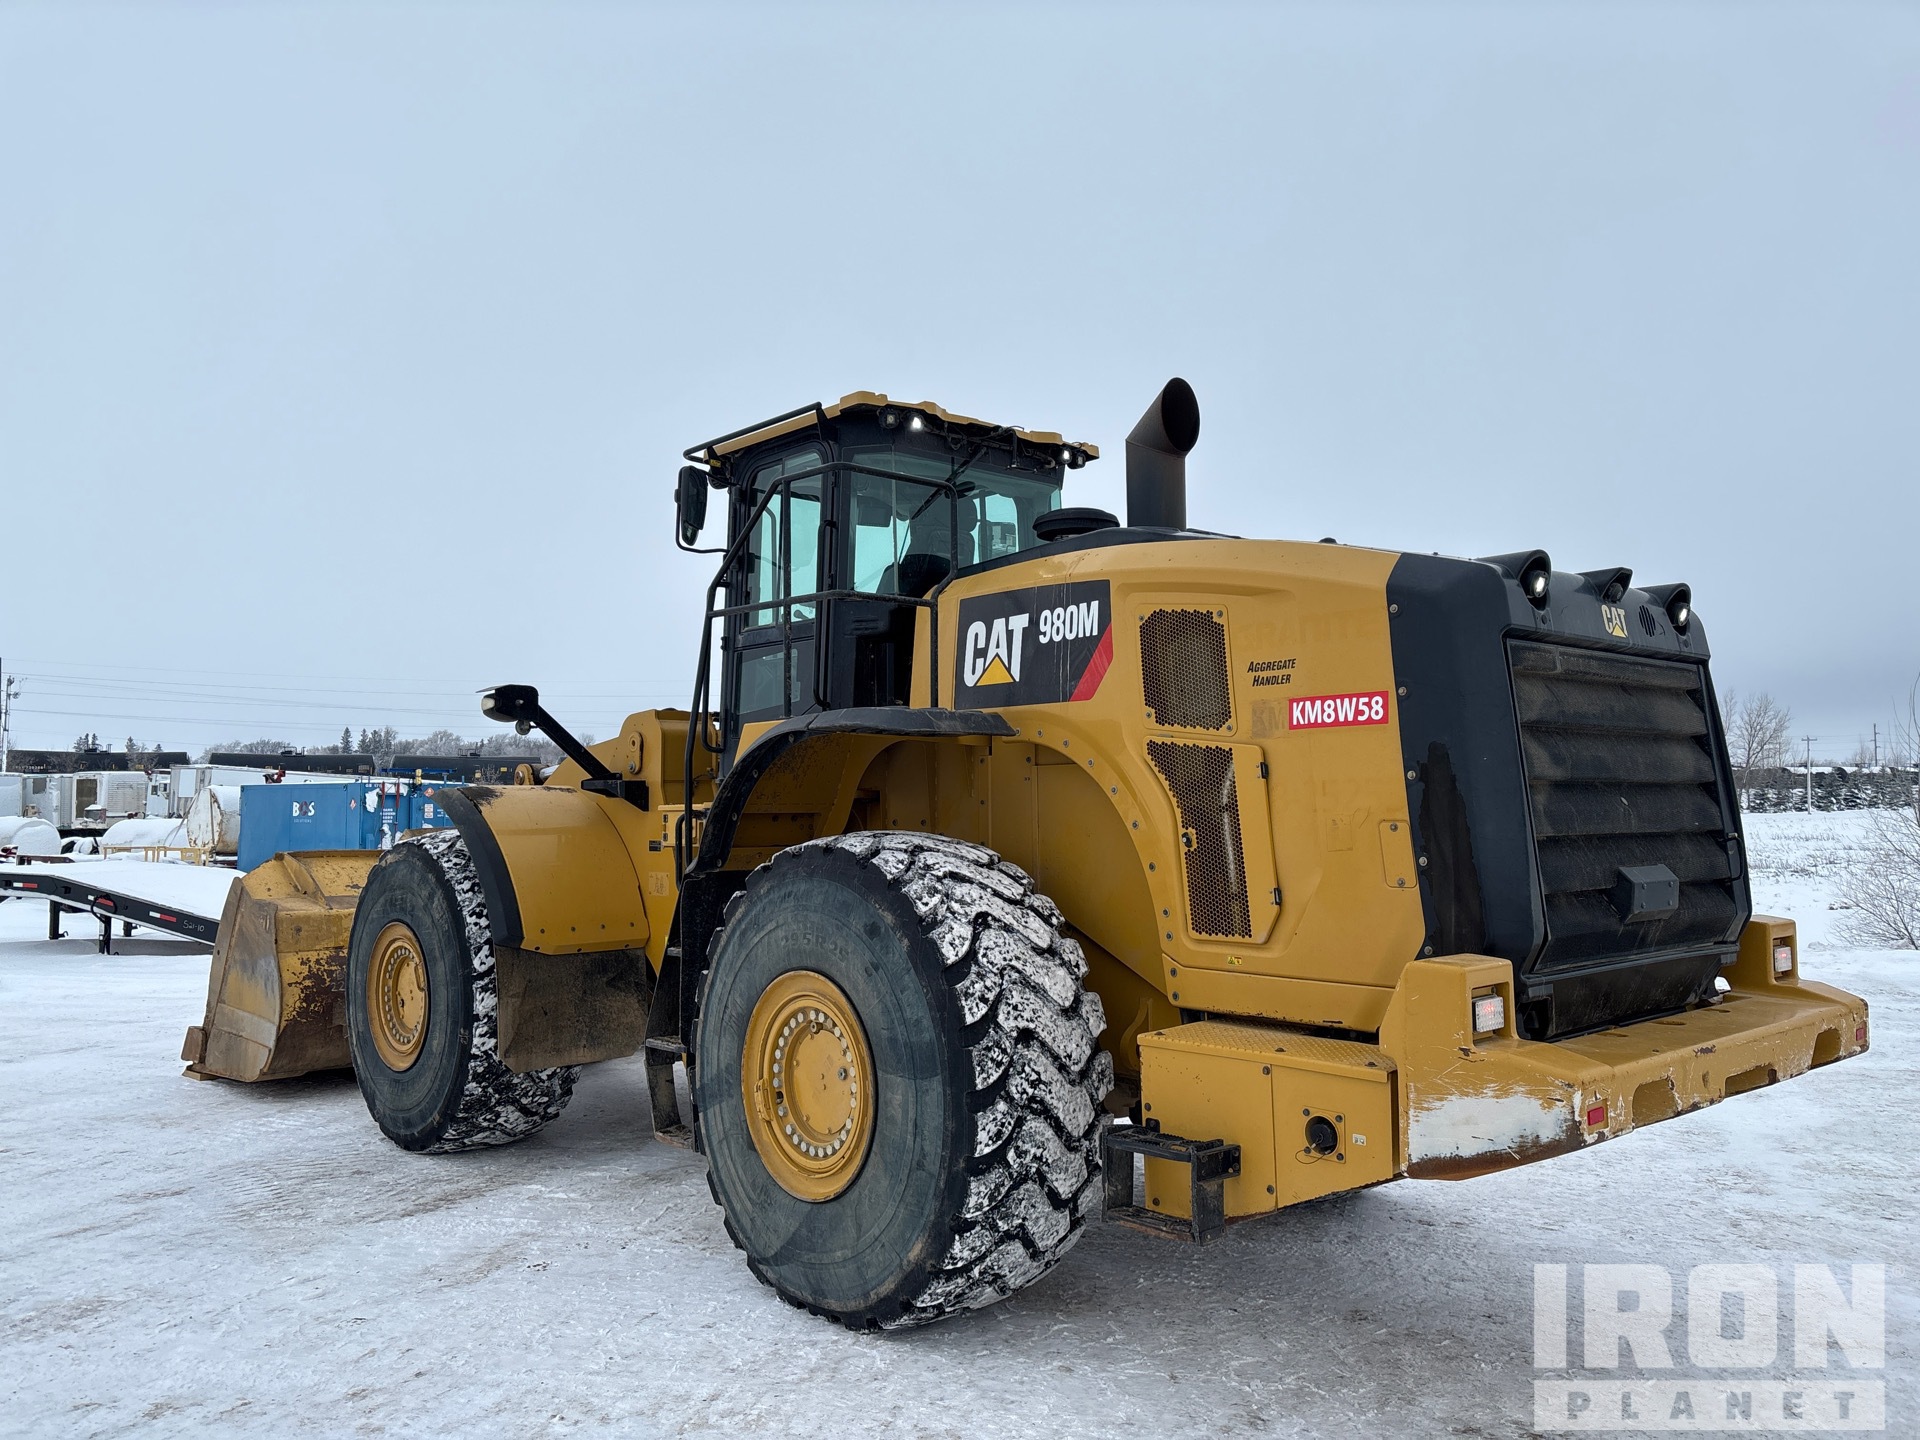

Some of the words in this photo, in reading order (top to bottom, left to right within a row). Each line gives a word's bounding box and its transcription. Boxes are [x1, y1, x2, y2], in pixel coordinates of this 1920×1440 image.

[1601, 604, 1628, 637] CAT
[963, 613, 1029, 687] CAT
[1038, 600, 1099, 644] 980M
[1292, 696, 1384, 726] KM8W58
